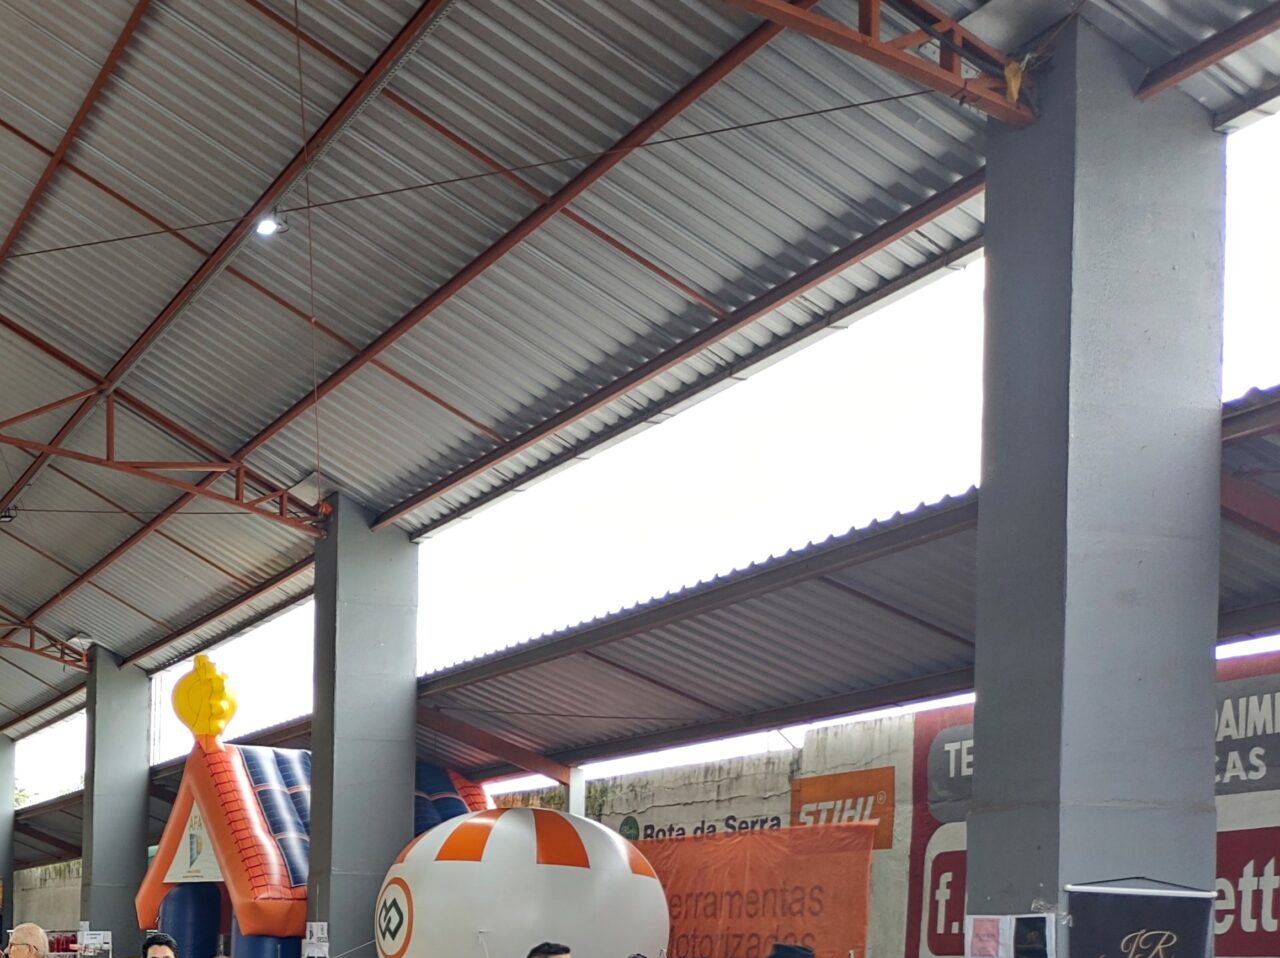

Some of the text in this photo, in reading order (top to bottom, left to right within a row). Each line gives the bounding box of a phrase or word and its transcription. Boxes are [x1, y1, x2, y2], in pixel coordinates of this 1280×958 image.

[1214, 692, 1280, 742] AIM
[1215, 746, 1266, 783] AS
[693, 820, 716, 838] da
[724, 815, 781, 835] Serra
[799, 796, 877, 827] STIHL
[664, 884, 825, 921] erramentas
